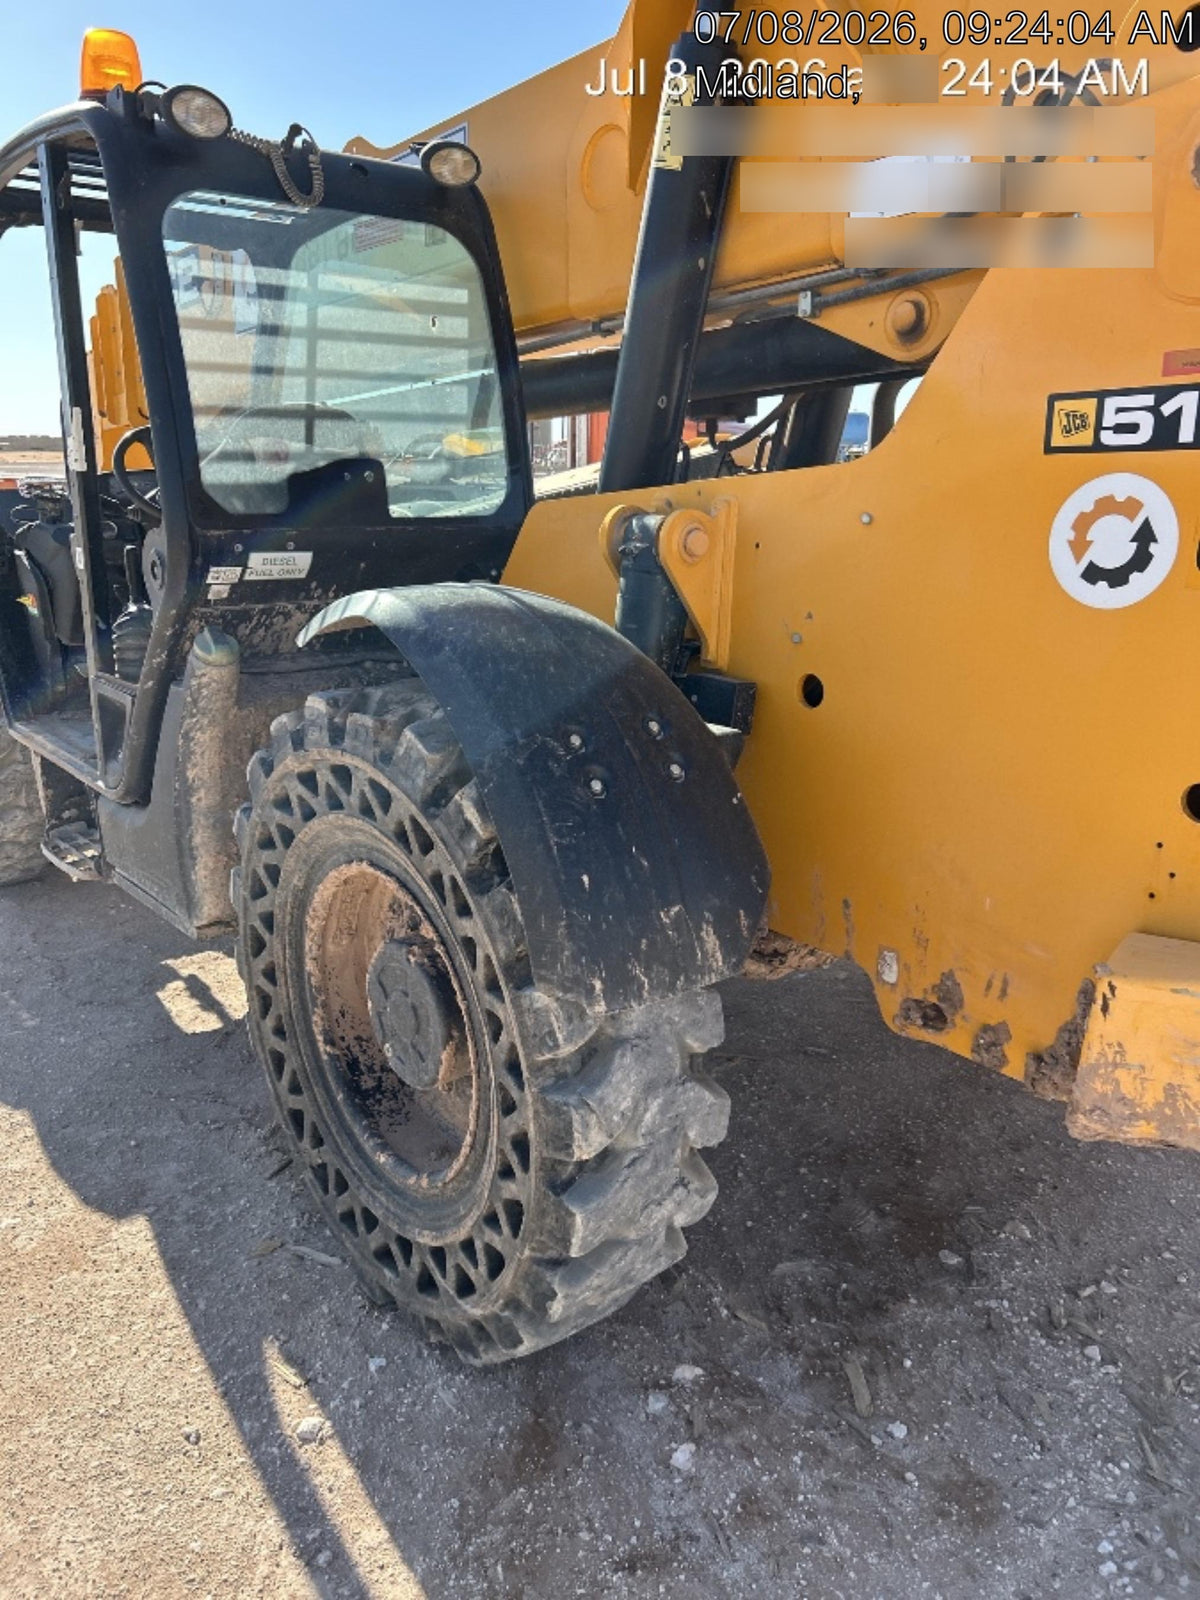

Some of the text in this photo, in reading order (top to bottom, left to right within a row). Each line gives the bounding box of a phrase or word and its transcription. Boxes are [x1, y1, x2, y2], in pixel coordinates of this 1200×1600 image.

[1060, 410, 1089, 436] JCB
[261, 556, 297, 567] DIESEL
[248, 568, 275, 577] FUEL
[277, 567, 306, 577] ONLY
